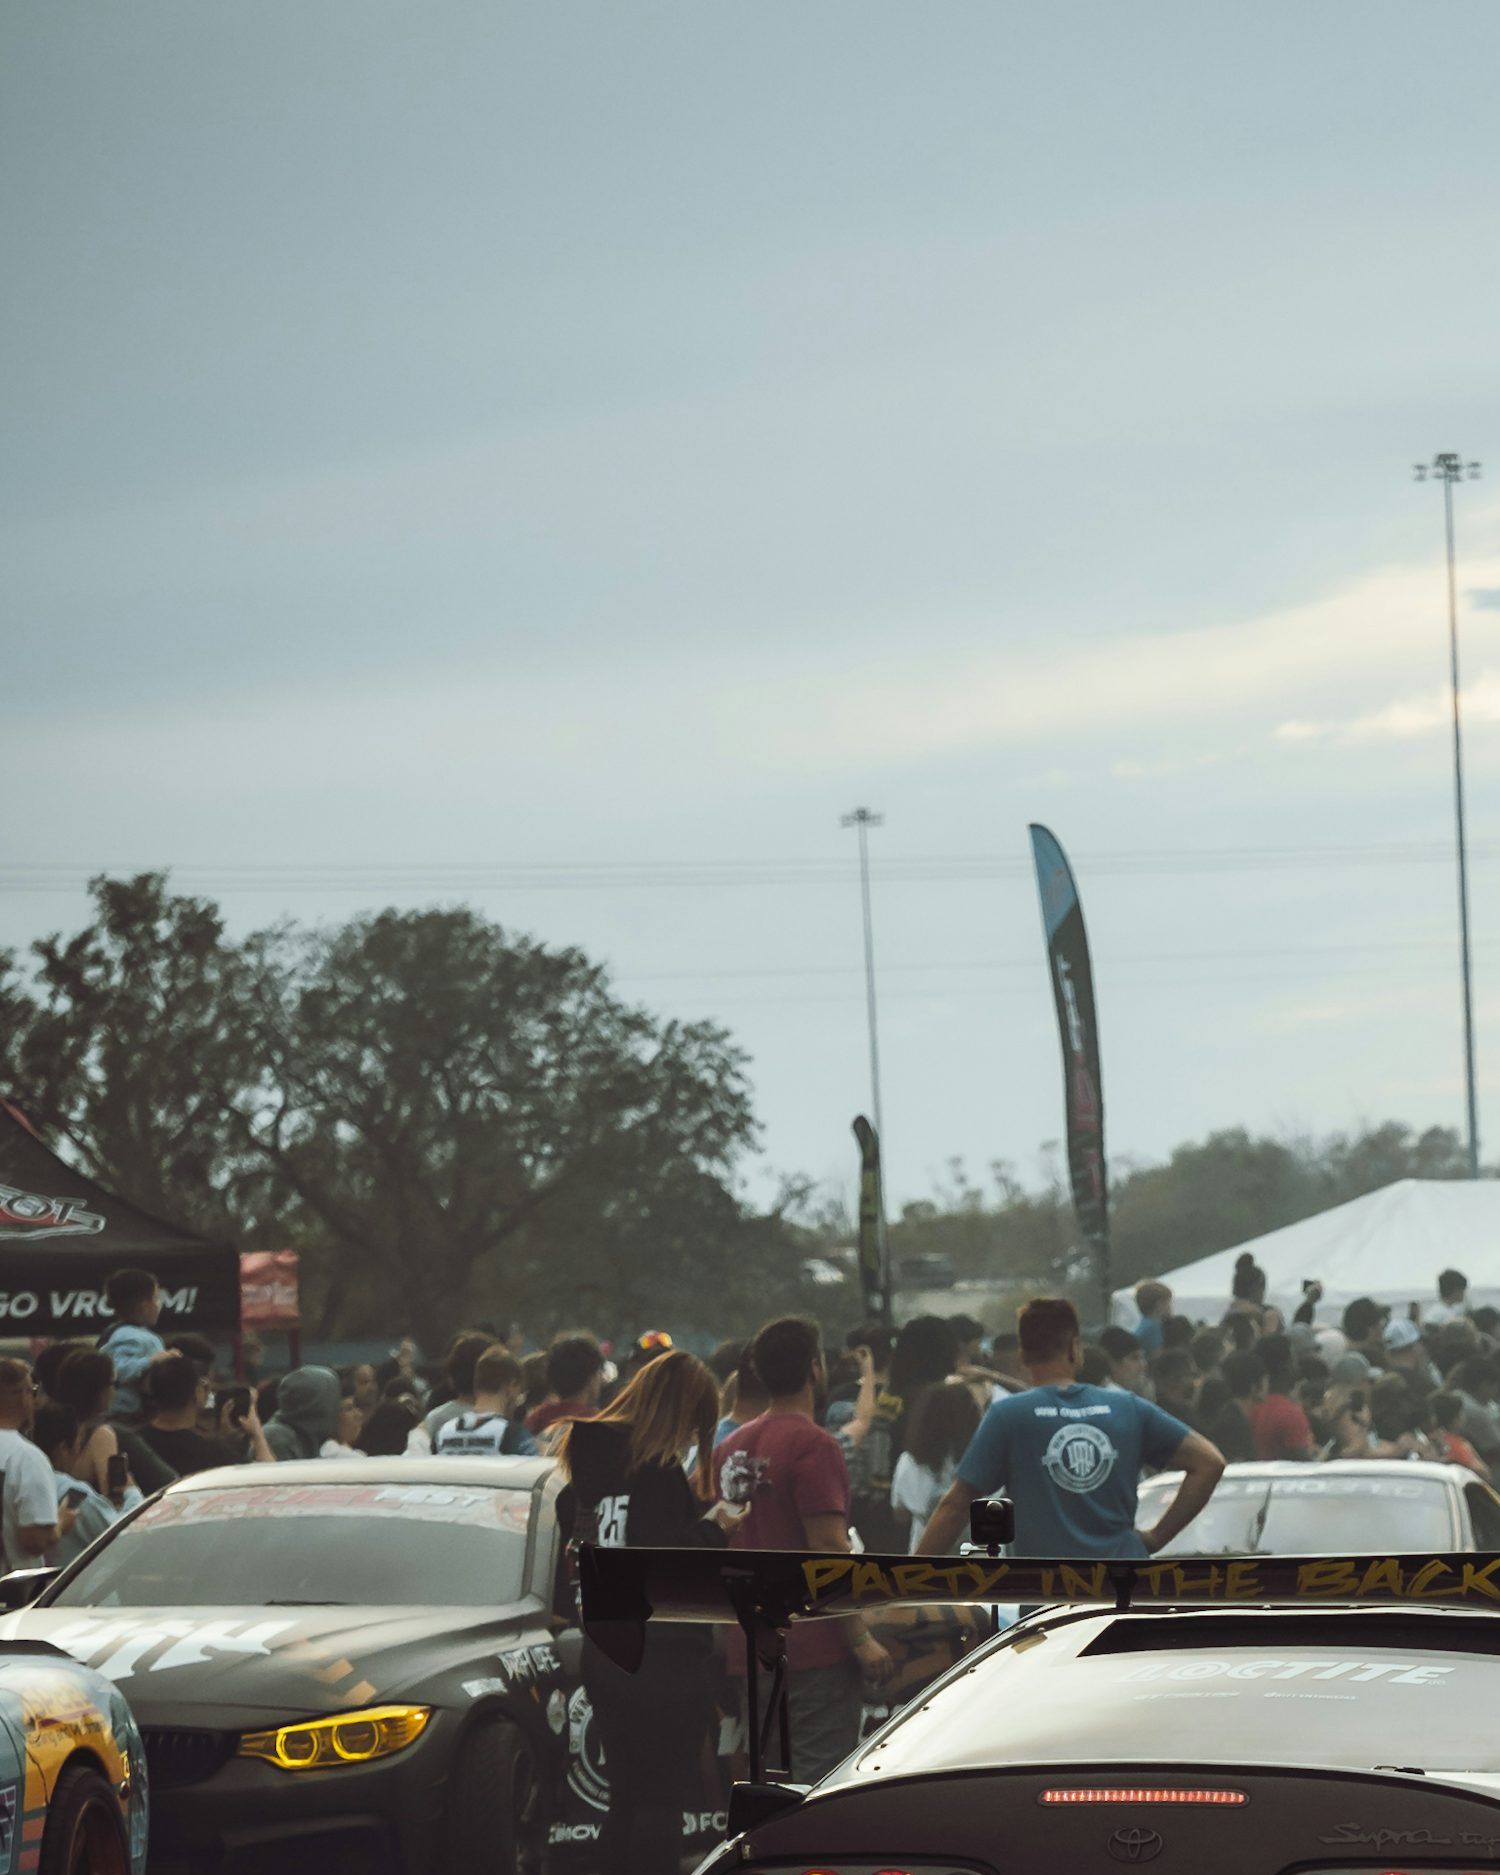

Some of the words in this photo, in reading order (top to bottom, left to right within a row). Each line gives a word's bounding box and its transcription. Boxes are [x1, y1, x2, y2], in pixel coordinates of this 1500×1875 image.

[801, 1557, 1010, 1600] PARTY
[1041, 1562, 1108, 1598] IN
[1134, 1559, 1265, 1599] THE
[1118, 1659, 1456, 1686] LOCTITE
[1317, 1821, 1452, 1852] Supra
